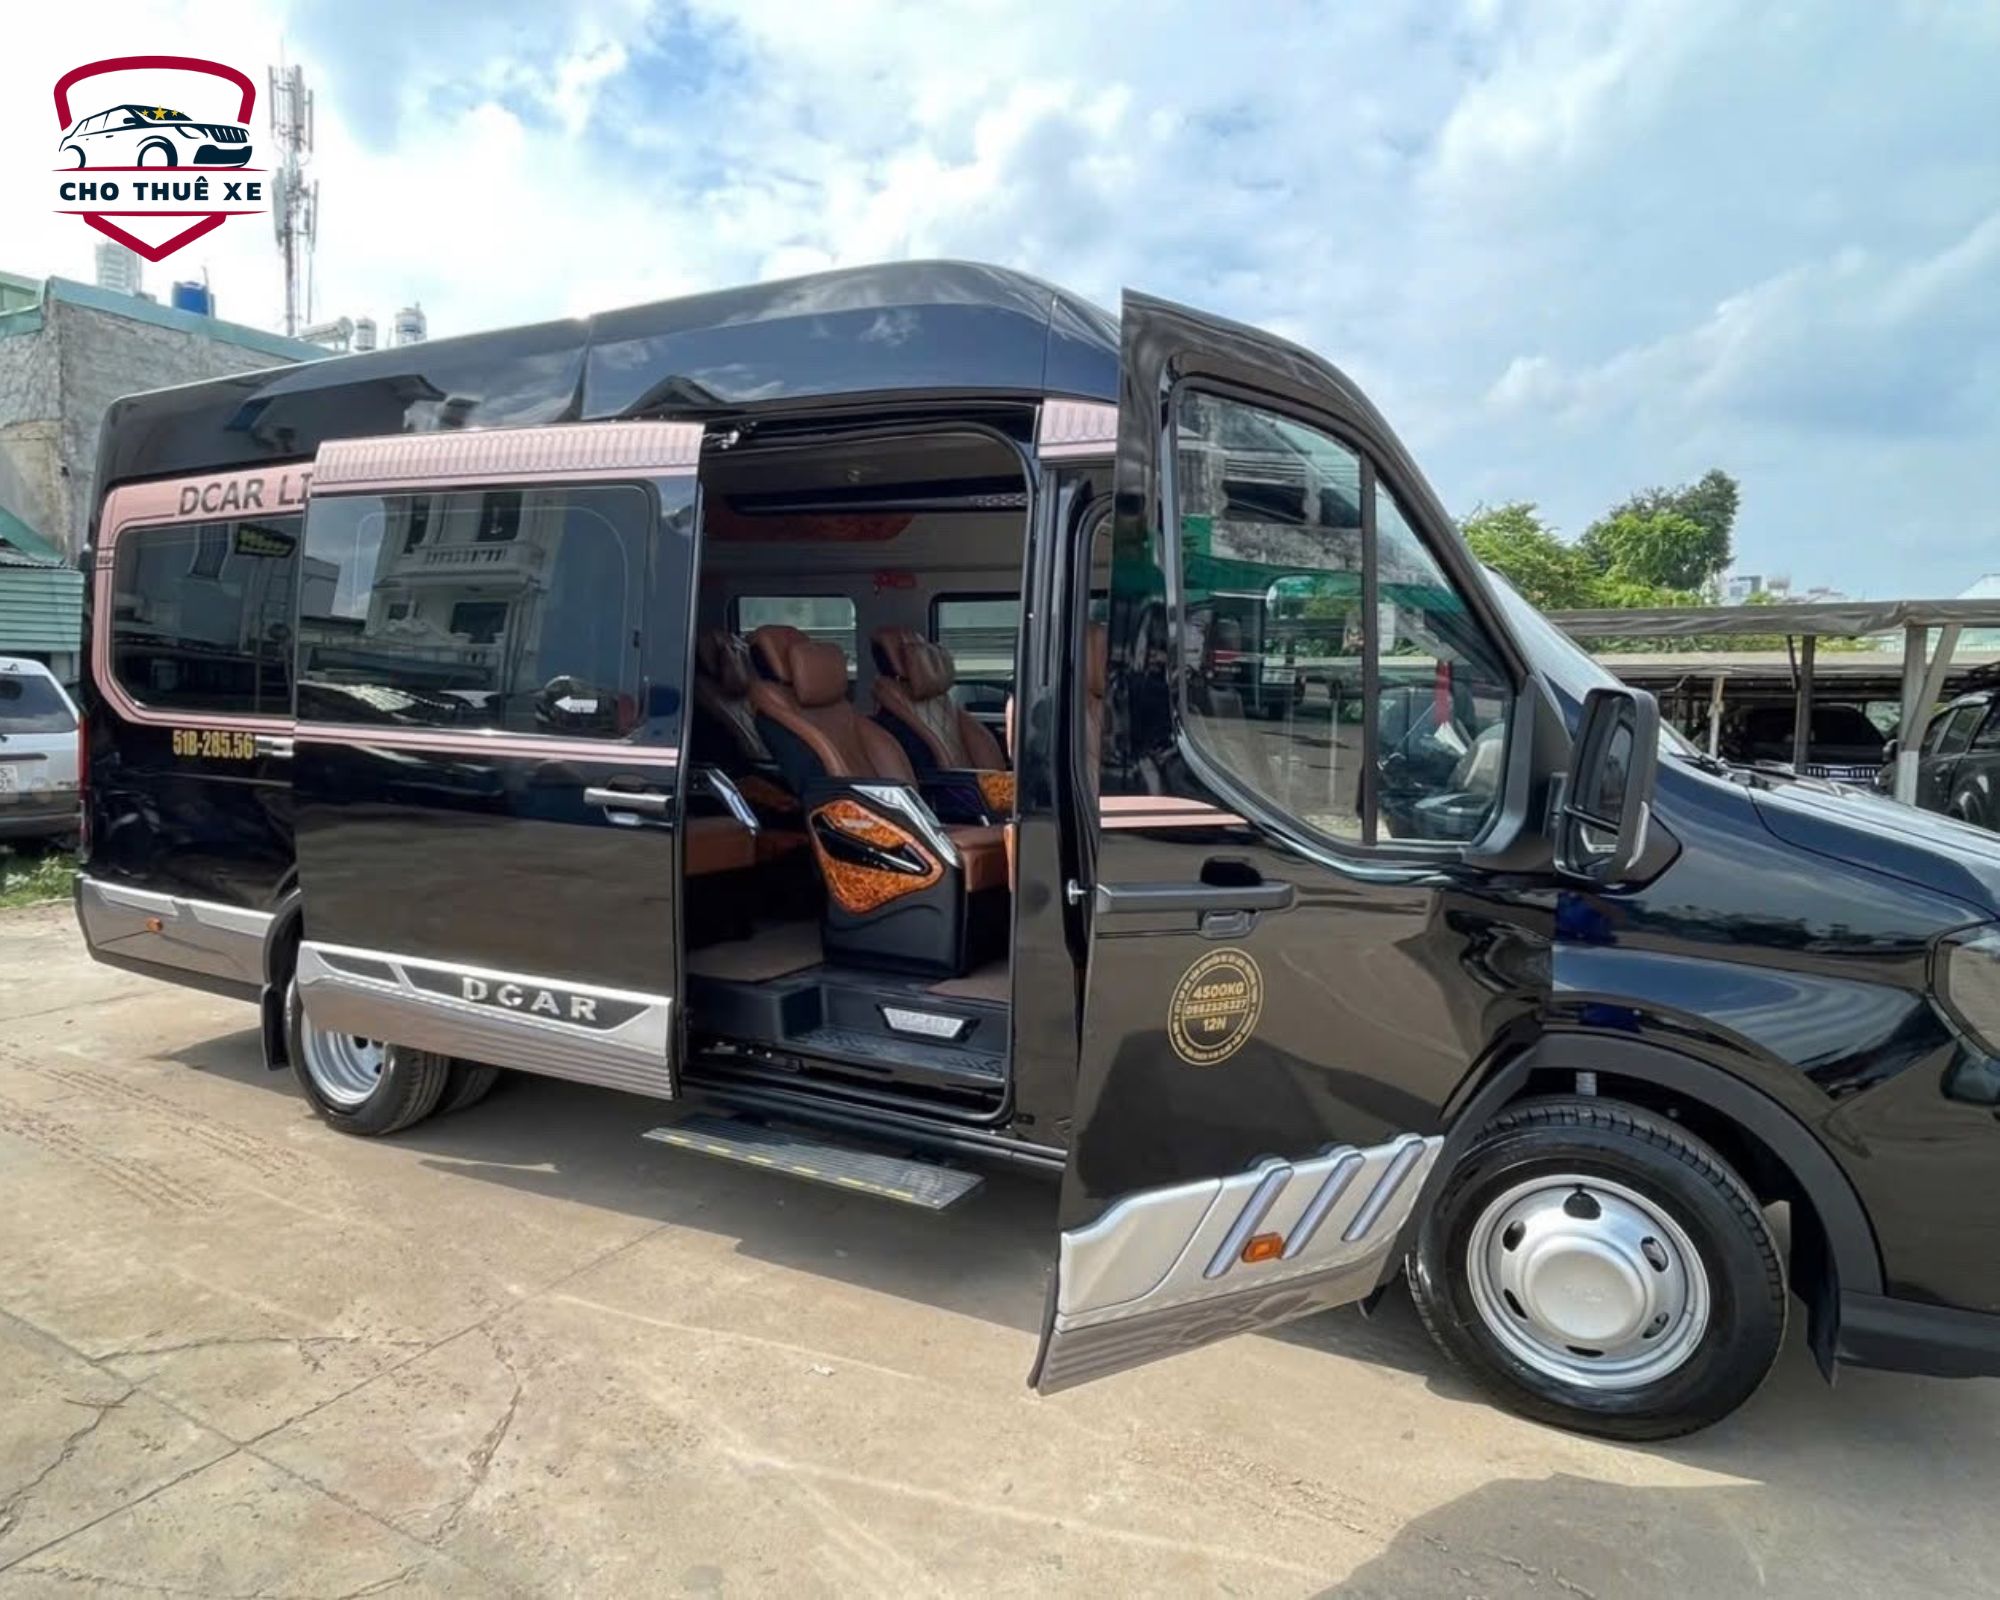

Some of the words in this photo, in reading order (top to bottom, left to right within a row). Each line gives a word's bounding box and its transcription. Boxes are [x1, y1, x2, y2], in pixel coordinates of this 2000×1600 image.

[179, 478, 265, 515] DCAR
[173, 730, 254, 760] 51B-285.56
[461, 976, 597, 1021] DCAR
